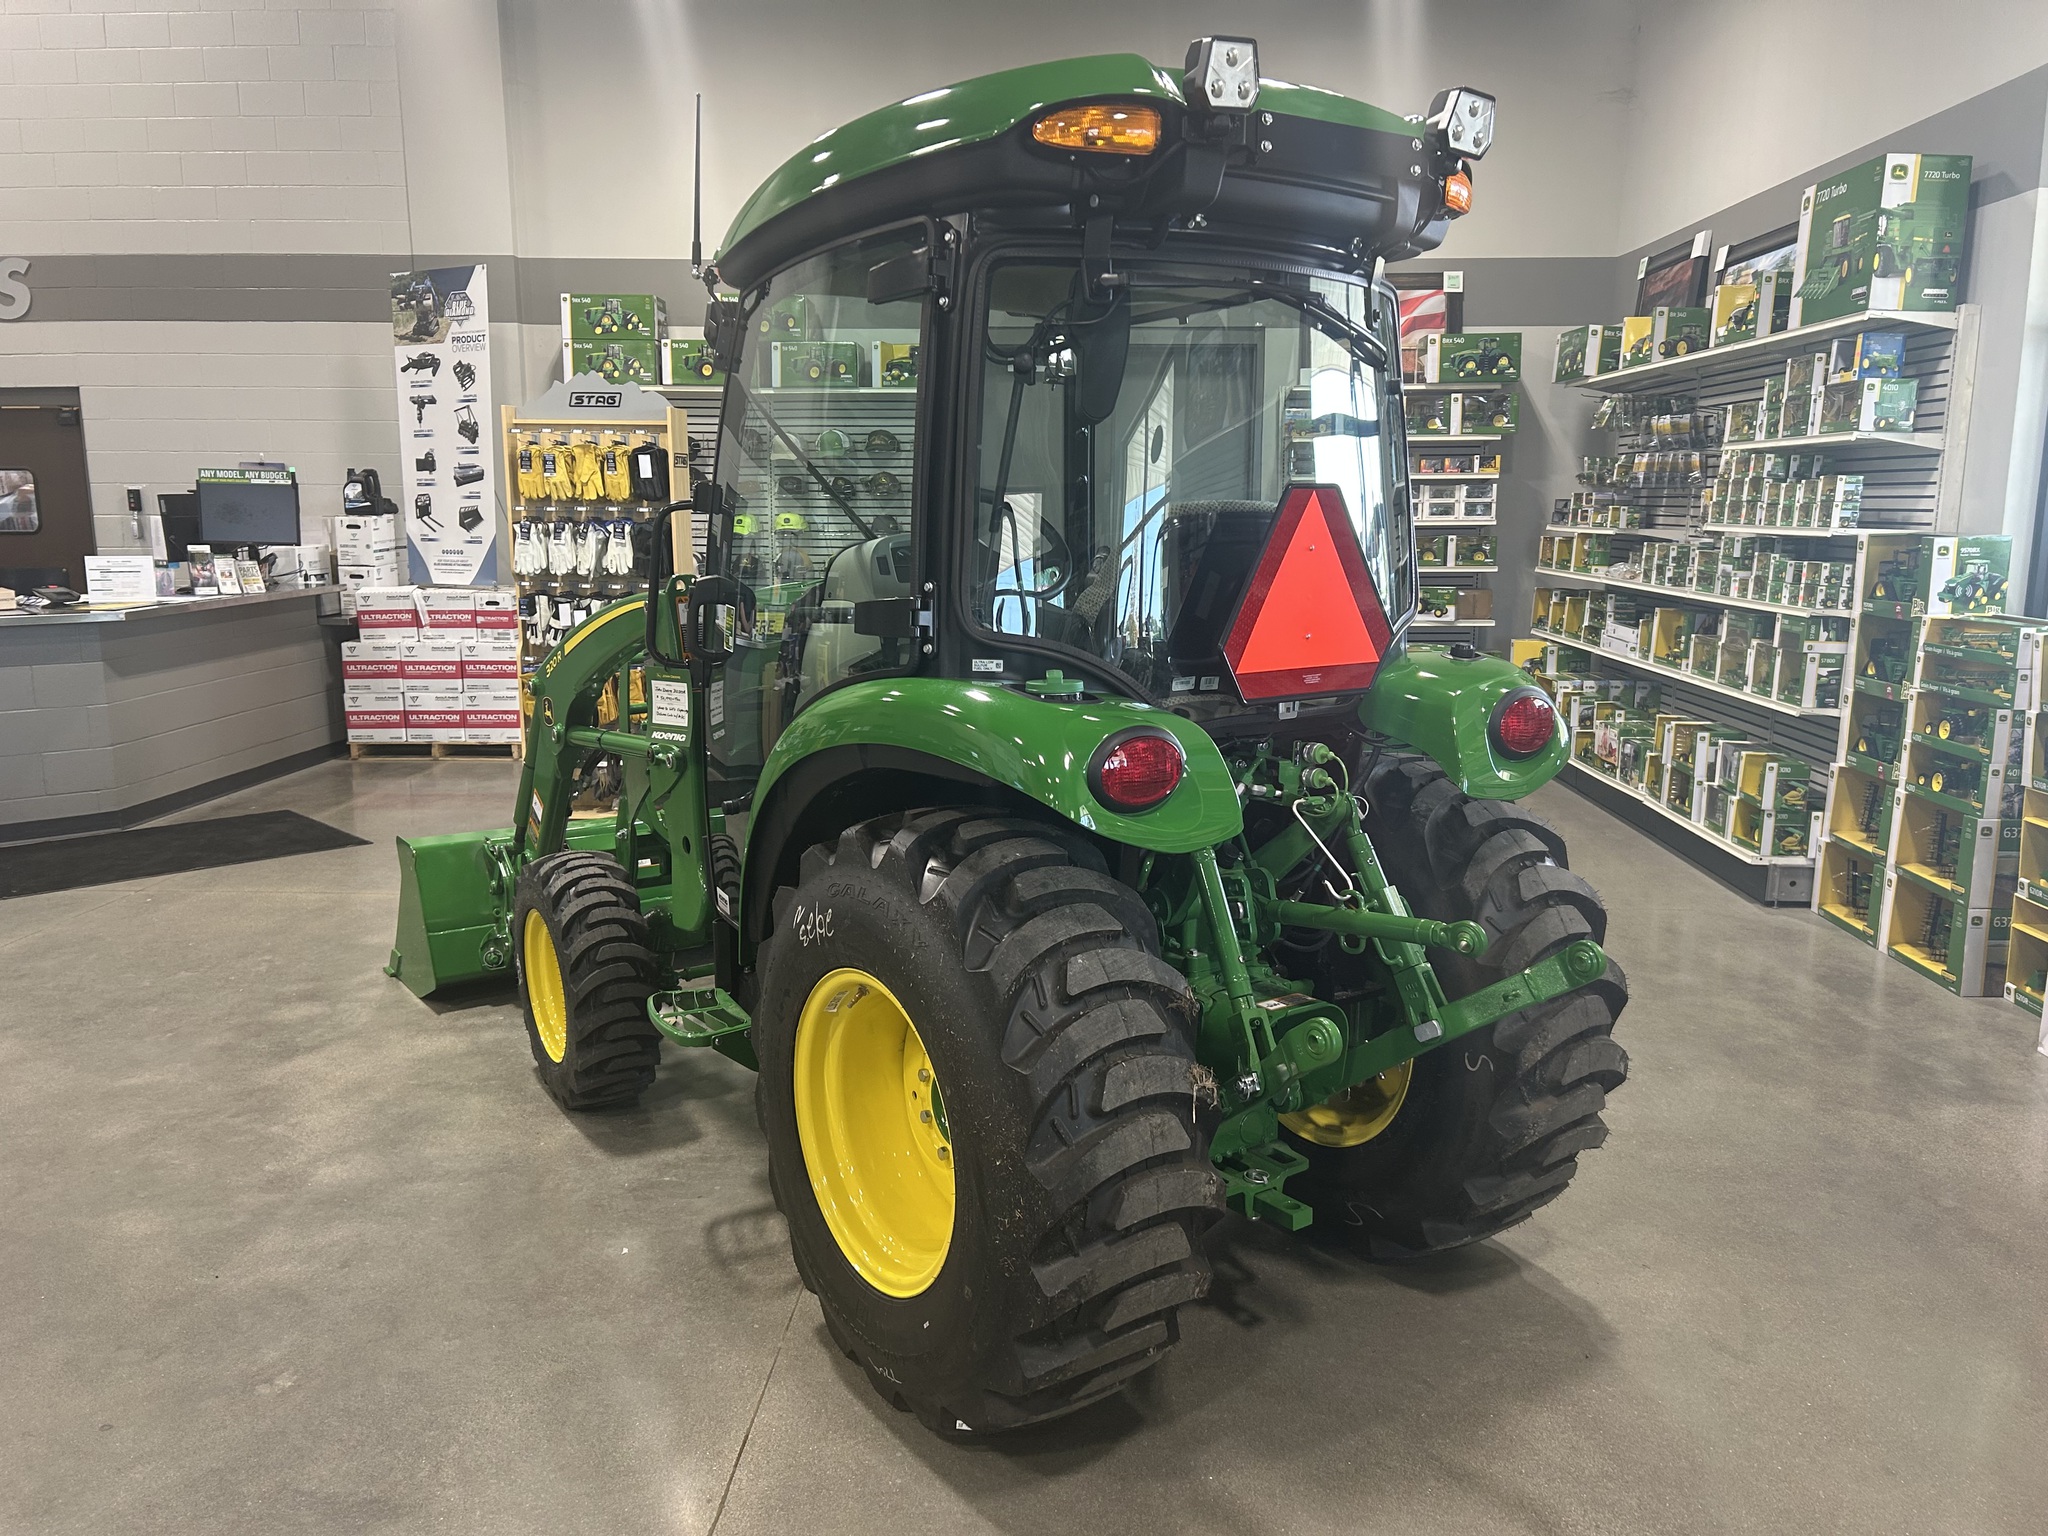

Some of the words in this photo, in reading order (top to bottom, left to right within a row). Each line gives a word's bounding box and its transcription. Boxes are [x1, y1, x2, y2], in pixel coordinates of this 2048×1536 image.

[1816, 188, 1830, 204] 7720
[1830, 183, 1847, 199] Turbo
[452, 300, 467, 308] BLUE
[445, 307, 474, 316] DIAMOND
[452, 334, 486, 344] PRODUCT
[452, 344, 486, 353] OVERVIEW
[574, 395, 617, 405] STAG
[674, 456, 687, 466] STAG
[200, 470, 214, 478] ANY
[217, 470, 243, 478] MODEL.
[1913, 599, 1924, 609] Big
